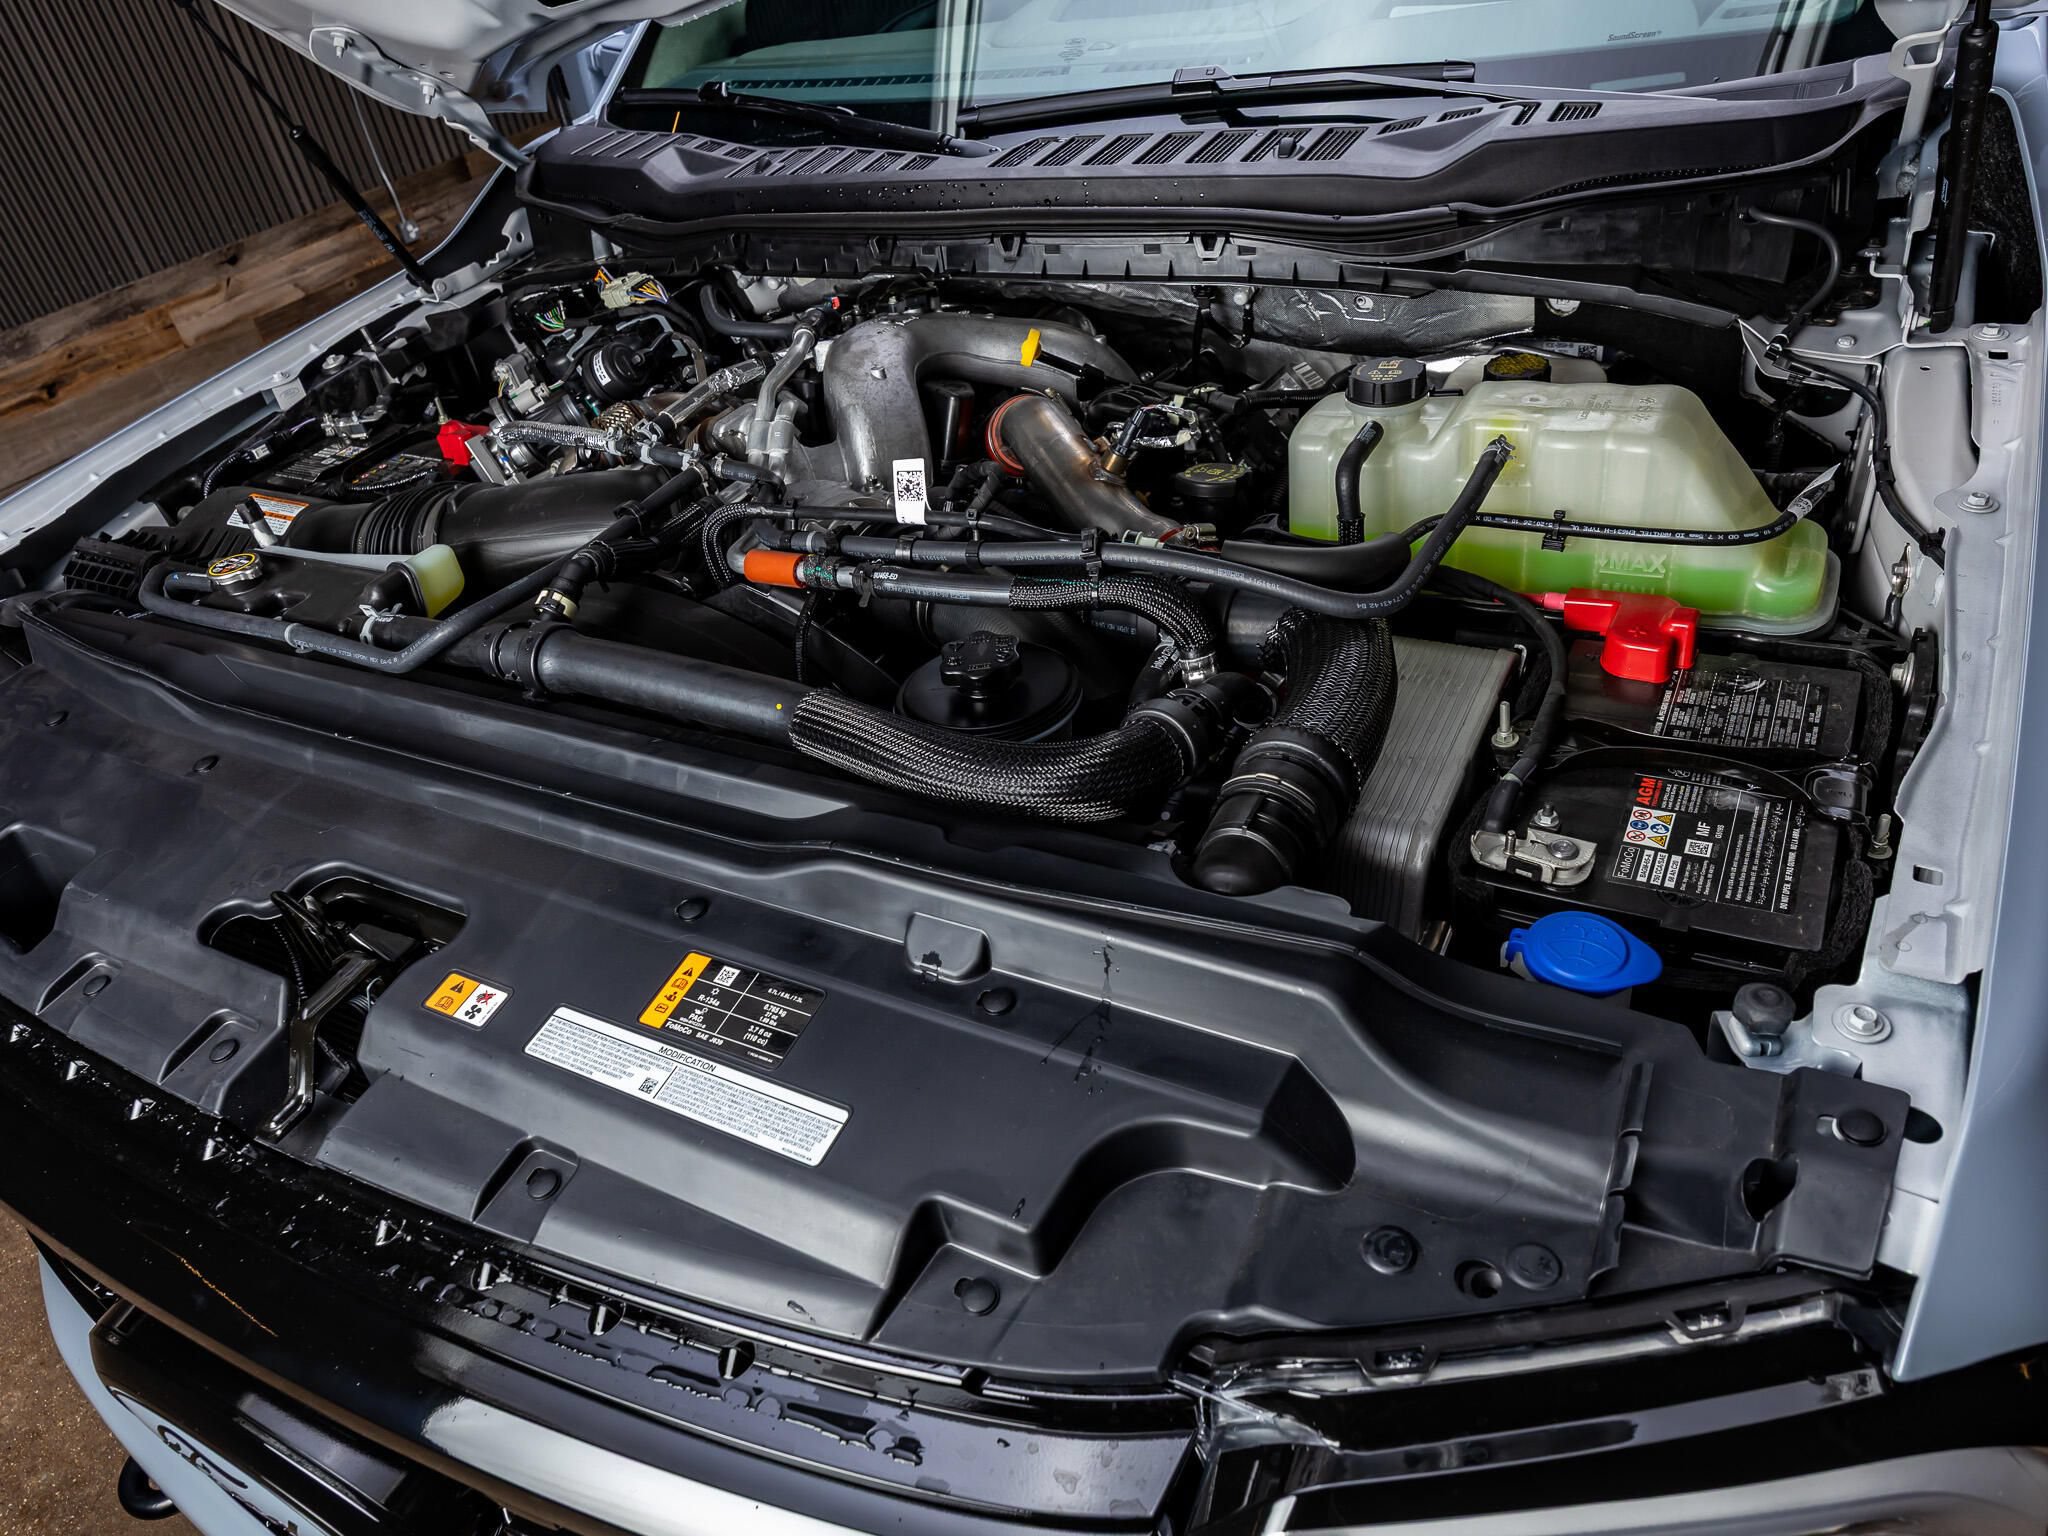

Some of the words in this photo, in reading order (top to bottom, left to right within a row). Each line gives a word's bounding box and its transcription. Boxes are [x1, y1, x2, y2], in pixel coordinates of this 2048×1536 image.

[1609, 551, 1668, 574] MAX
[1636, 778, 1655, 805] AGM
[1696, 821, 1710, 836] MF
[1619, 847, 1634, 877] FoMoCo
[688, 1014, 704, 1022] PAG
[777, 1009, 787, 1017] kg
[665, 1022, 693, 1034] FoMoCo
[696, 1032, 709, 1040] SAE
[658, 1046, 717, 1073] MODIFICATION
